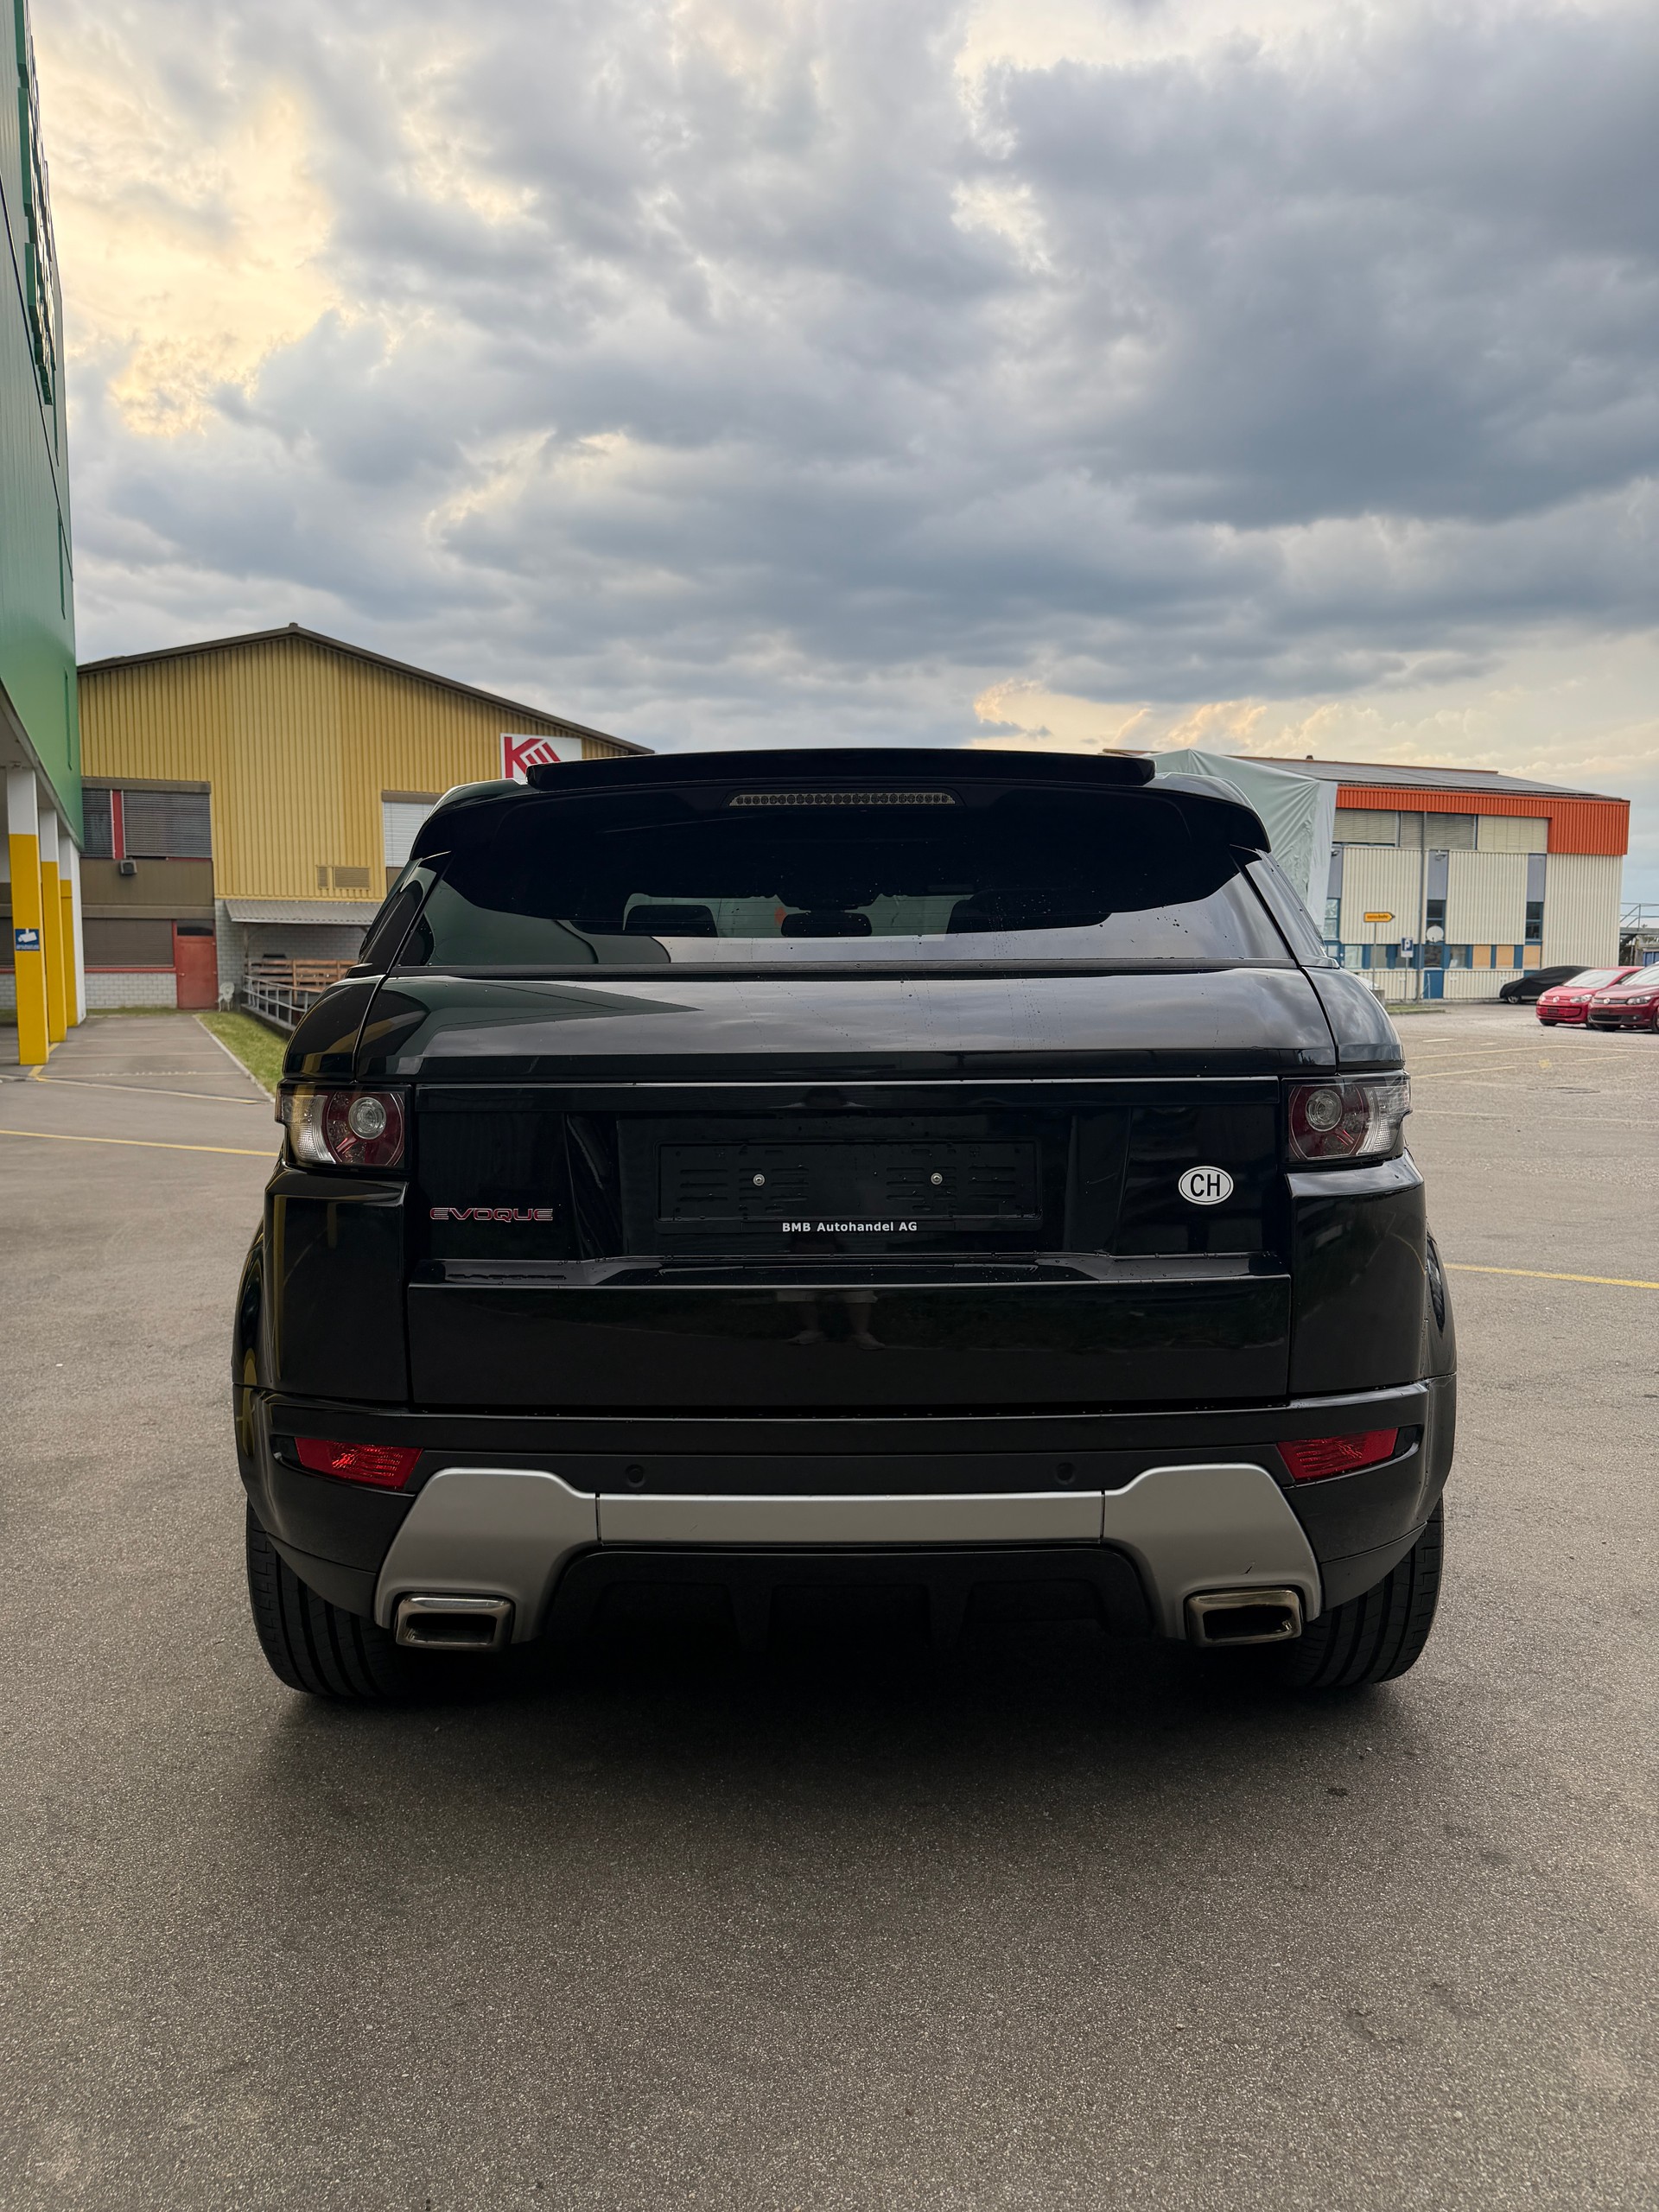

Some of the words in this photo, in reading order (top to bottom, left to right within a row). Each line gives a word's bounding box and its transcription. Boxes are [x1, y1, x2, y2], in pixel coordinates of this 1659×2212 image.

[1404, 939, 1411, 950] P
[1190, 1173, 1220, 1197] CH
[430, 1207, 553, 1223] EVOQUE
[782, 1223, 811, 1232] BMB
[817, 1222, 894, 1232] Autohandel
[899, 1222, 918, 1231] AG
